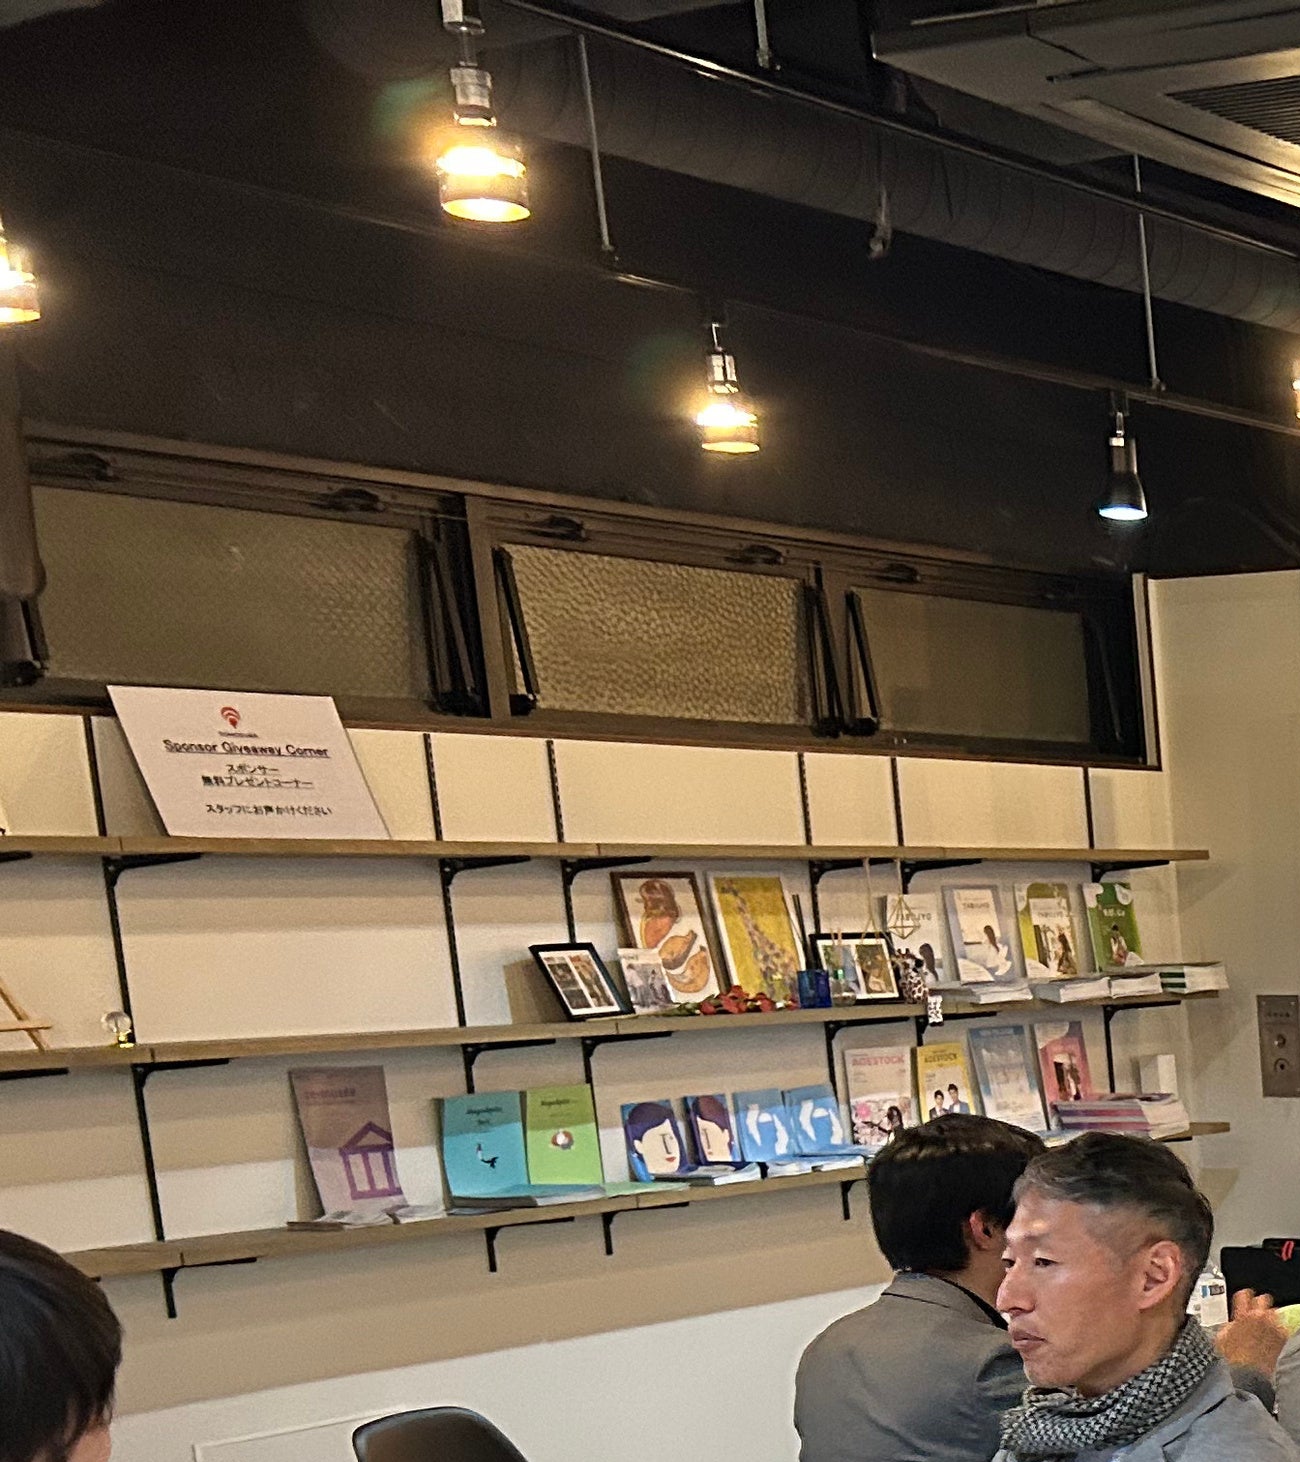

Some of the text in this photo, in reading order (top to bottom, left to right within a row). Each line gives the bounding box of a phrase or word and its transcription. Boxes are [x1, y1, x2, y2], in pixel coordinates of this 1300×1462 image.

[163, 739, 218, 753] Sponsor
[285, 744, 329, 757] Corner
[225, 763, 279, 775] スポンサー
